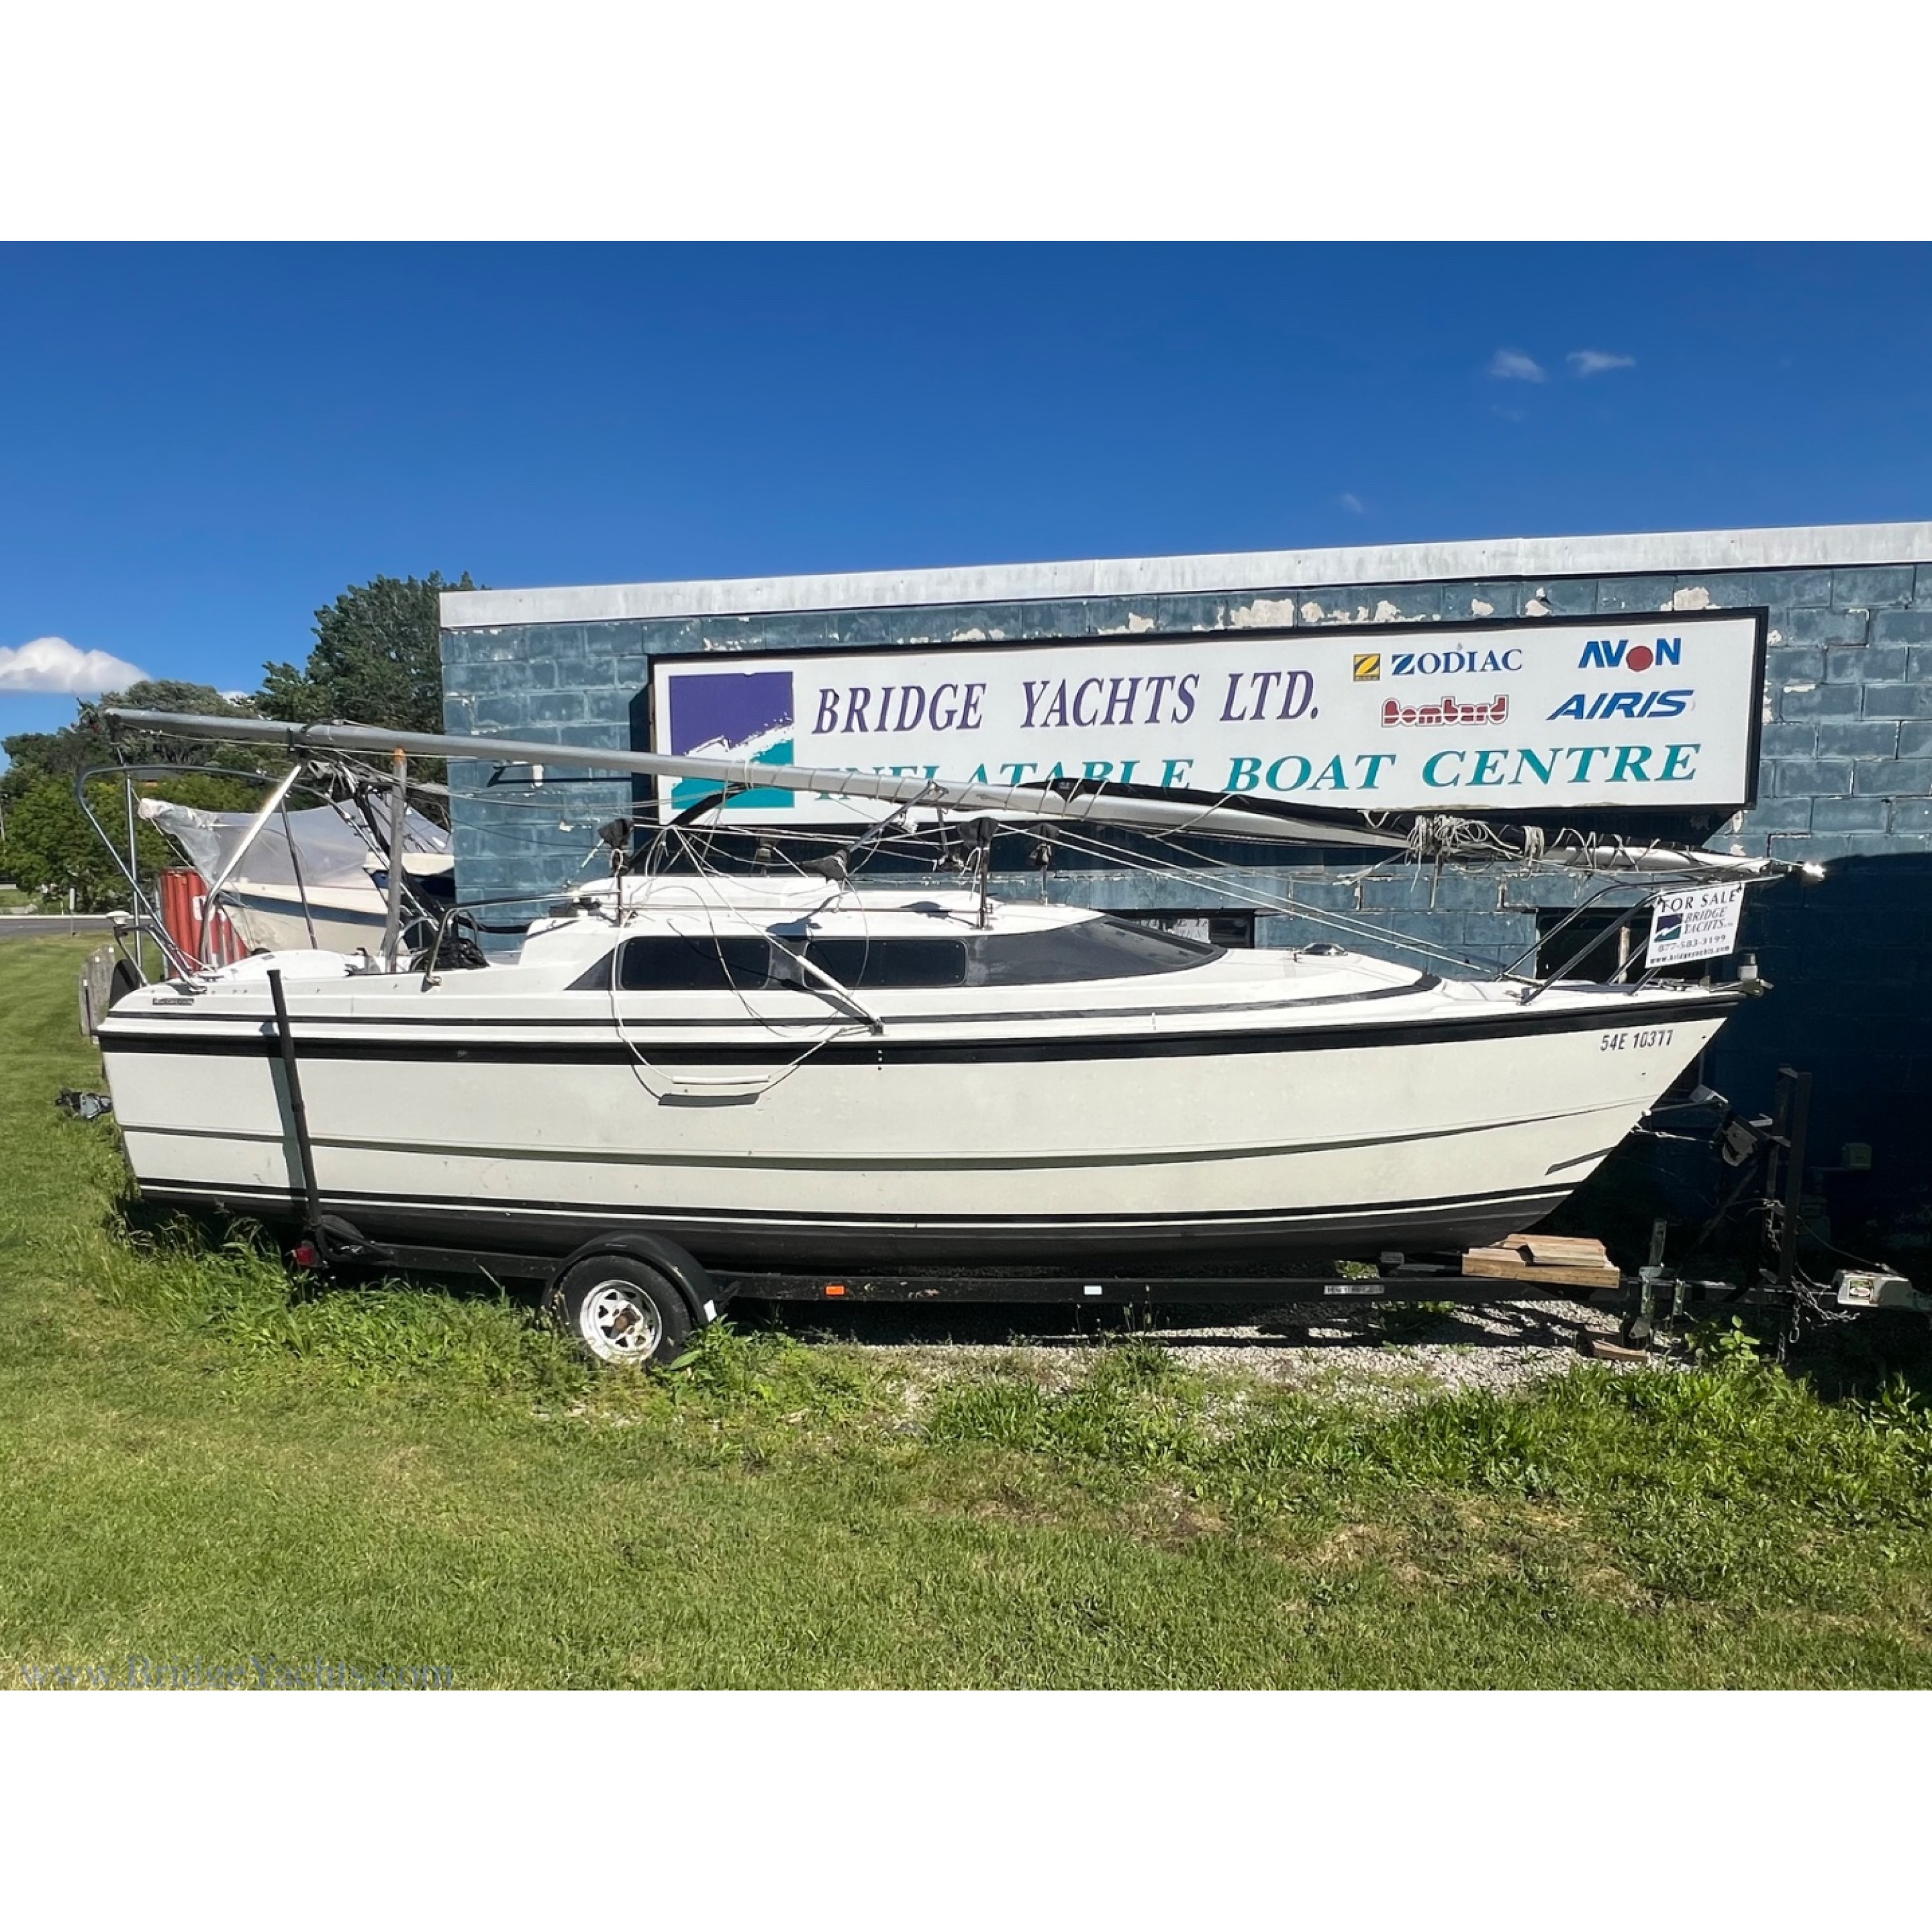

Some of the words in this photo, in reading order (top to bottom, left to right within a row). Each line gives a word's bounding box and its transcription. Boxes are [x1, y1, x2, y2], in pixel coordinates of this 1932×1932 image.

[1392, 648, 1523, 676] ZODIAC
[1578, 638, 1681, 672] AVON
[811, 683, 987, 734] BRIDGE
[1020, 674, 1200, 729] YACHTS
[1219, 670, 1319, 722] LTD.
[1546, 688, 1695, 721] AIRIS
[815, 759, 1194, 800] ATABLE
[1220, 754, 1397, 792] BOAT
[1421, 744, 1701, 788] CENTRE
[1660, 895, 1694, 913] FOR
[1700, 889, 1738, 907] SALE
[1684, 906, 1728, 923] BRIDGE
[1600, 1032, 1629, 1052] 54E
[1633, 1029, 1674, 1049] 10377
